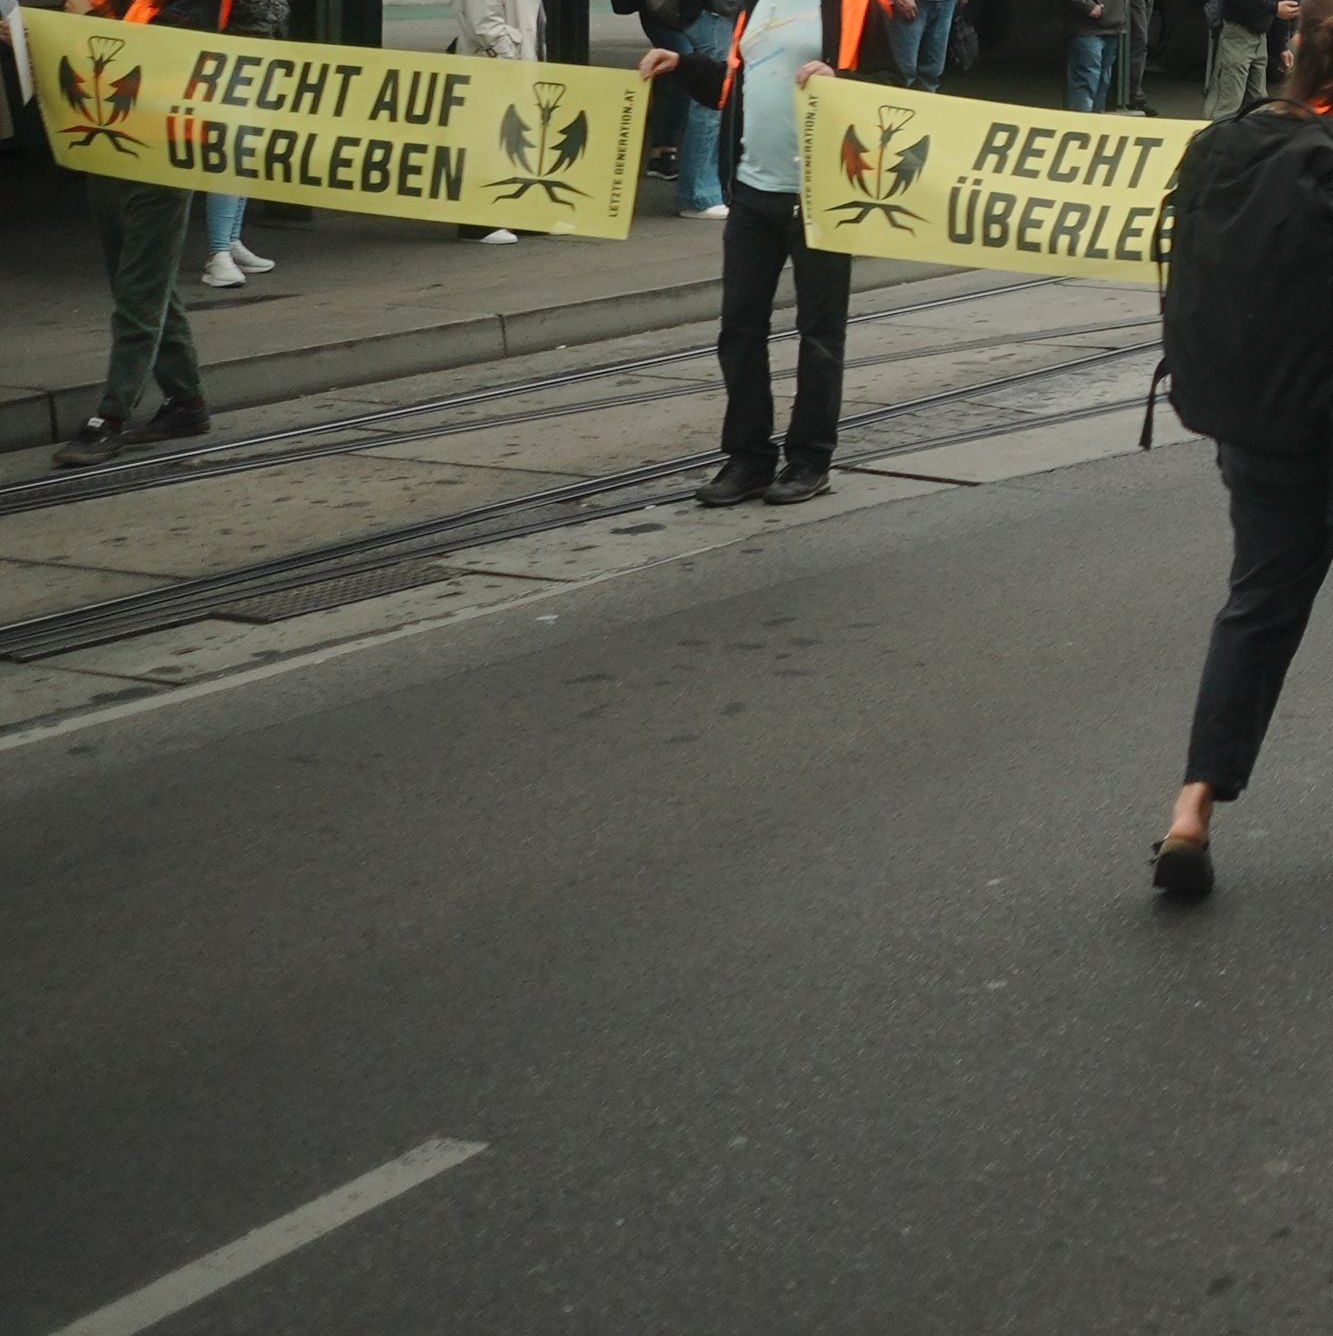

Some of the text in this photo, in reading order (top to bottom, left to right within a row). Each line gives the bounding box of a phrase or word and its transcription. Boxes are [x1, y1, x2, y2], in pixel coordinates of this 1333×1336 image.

[183, 50, 472, 127] RECHT AUF
[166, 105, 468, 202] ÜBERLEBEN
[971, 121, 1165, 190] RECHT
[948, 176, 1176, 263] ÜBERLEB
